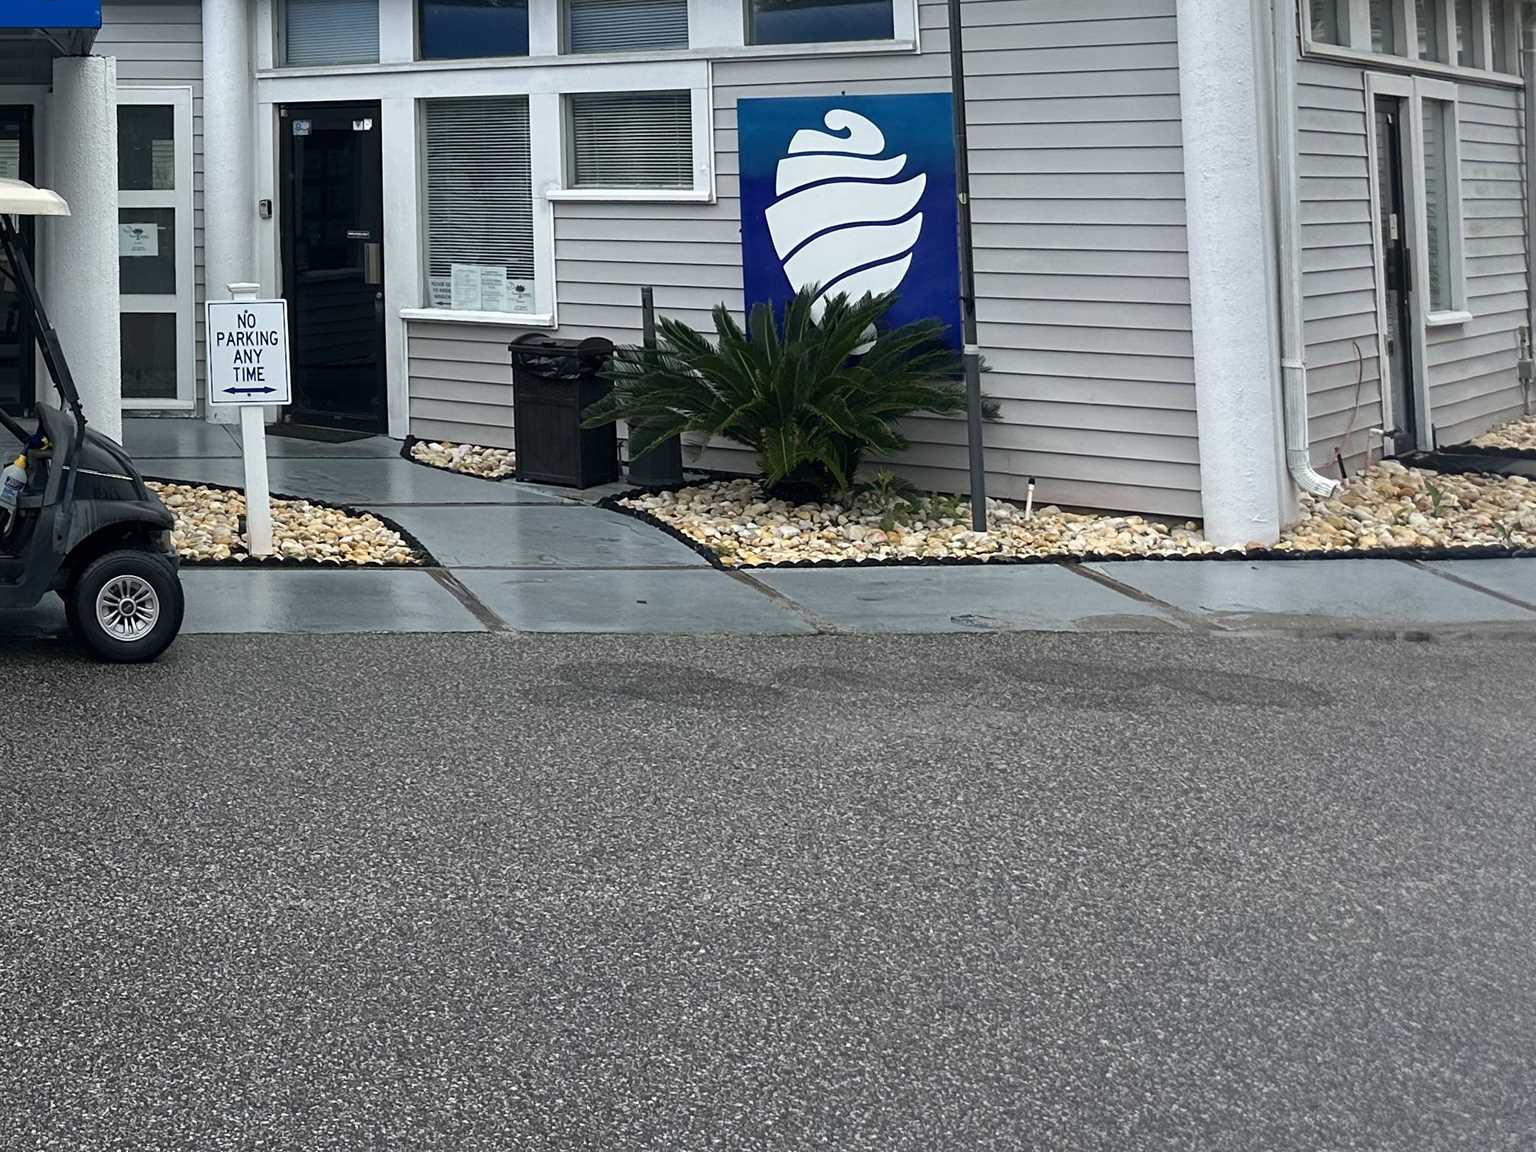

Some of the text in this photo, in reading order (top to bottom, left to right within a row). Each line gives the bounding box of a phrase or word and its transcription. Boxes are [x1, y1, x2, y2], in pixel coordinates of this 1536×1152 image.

[237, 313, 256, 328] NO
[216, 331, 278, 346] PARKING
[233, 349, 263, 364] ANY
[233, 366, 265, 382] TIME
